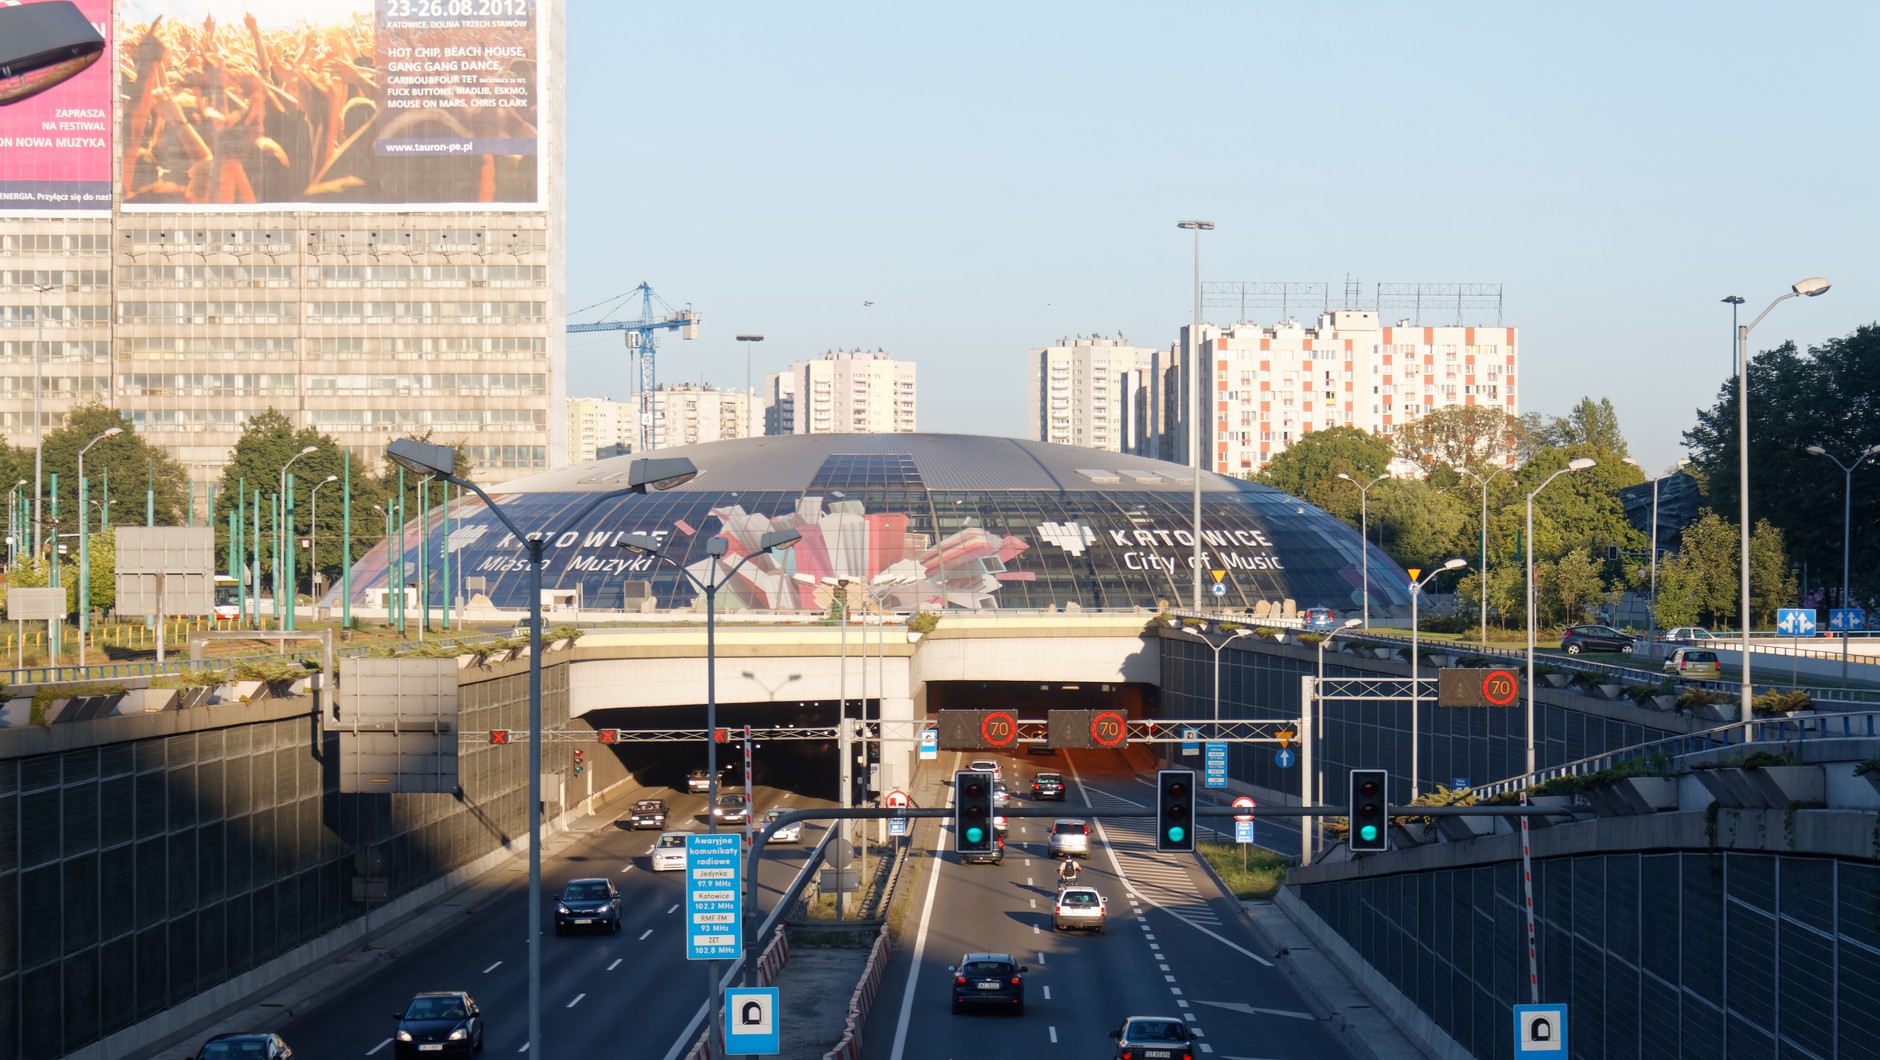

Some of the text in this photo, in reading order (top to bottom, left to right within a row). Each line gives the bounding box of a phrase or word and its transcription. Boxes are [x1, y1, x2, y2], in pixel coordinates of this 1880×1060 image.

[387, 0, 526, 17] 23-26.08.2012
[387, 21, 428, 29] KATOWICE,
[462, 20, 490, 28] TRZECH
[492, 19, 528, 28] STAWÓW
[388, 46, 526, 58] HOT CHIP, BEACH HOUSE,
[388, 61, 502, 72] GANG GANG DANCE,
[388, 75, 460, 84] CARIBOU&FOUR
[462, 75, 478, 83] TET
[388, 87, 528, 97] FUCK BUTTONS, MADLIB, ESKMO,
[388, 99, 528, 108] MOUSE ON MARS, CHRIS CLARK
[56, 109, 105, 118] ZAPRASZA
[42, 121, 105, 130] NA FESTIWAL
[16, 137, 52, 147] NOWA
[56, 137, 106, 148] MUZYKA
[386, 142, 472, 153] www.tauron-pe.pl
[1109, 530, 1273, 547] KATOWICE
[567, 555, 655, 576] Muzyki
[1124, 552, 1174, 574] City
[1220, 552, 1284, 570] Music
[1492, 680, 1510, 695] 70
[990, 722, 1008, 736] 70
[1100, 722, 1118, 736] 70
[695, 837, 732, 846] Awaryjne
[690, 847, 738, 856] komunikaty
